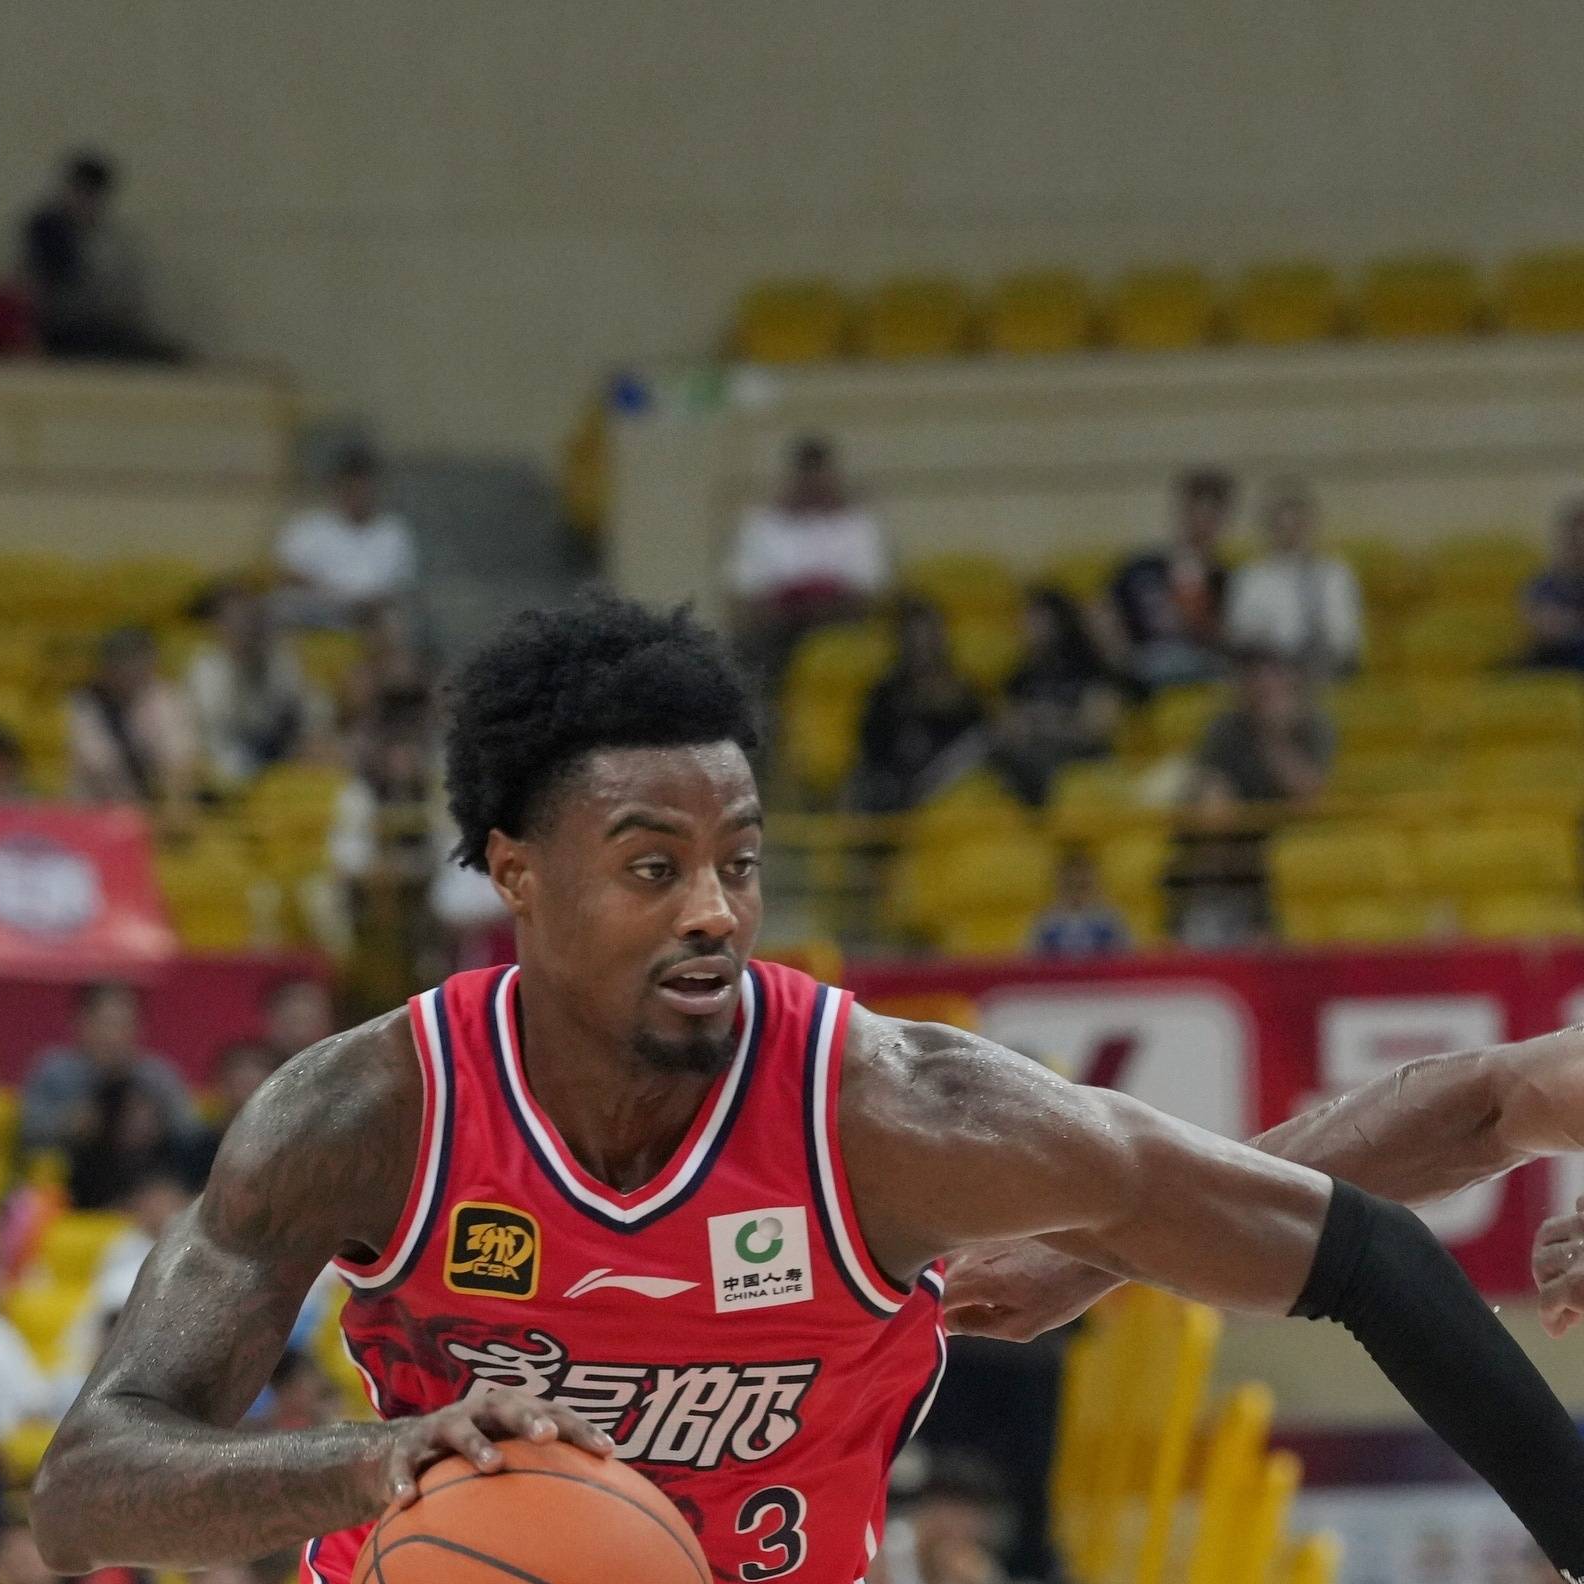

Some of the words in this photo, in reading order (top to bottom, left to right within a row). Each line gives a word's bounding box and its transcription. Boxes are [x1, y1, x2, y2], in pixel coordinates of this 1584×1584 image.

[722, 1267, 804, 1292] 中国人寿
[723, 1289, 769, 1303] CHINA
[772, 1283, 804, 1296] LIFE
